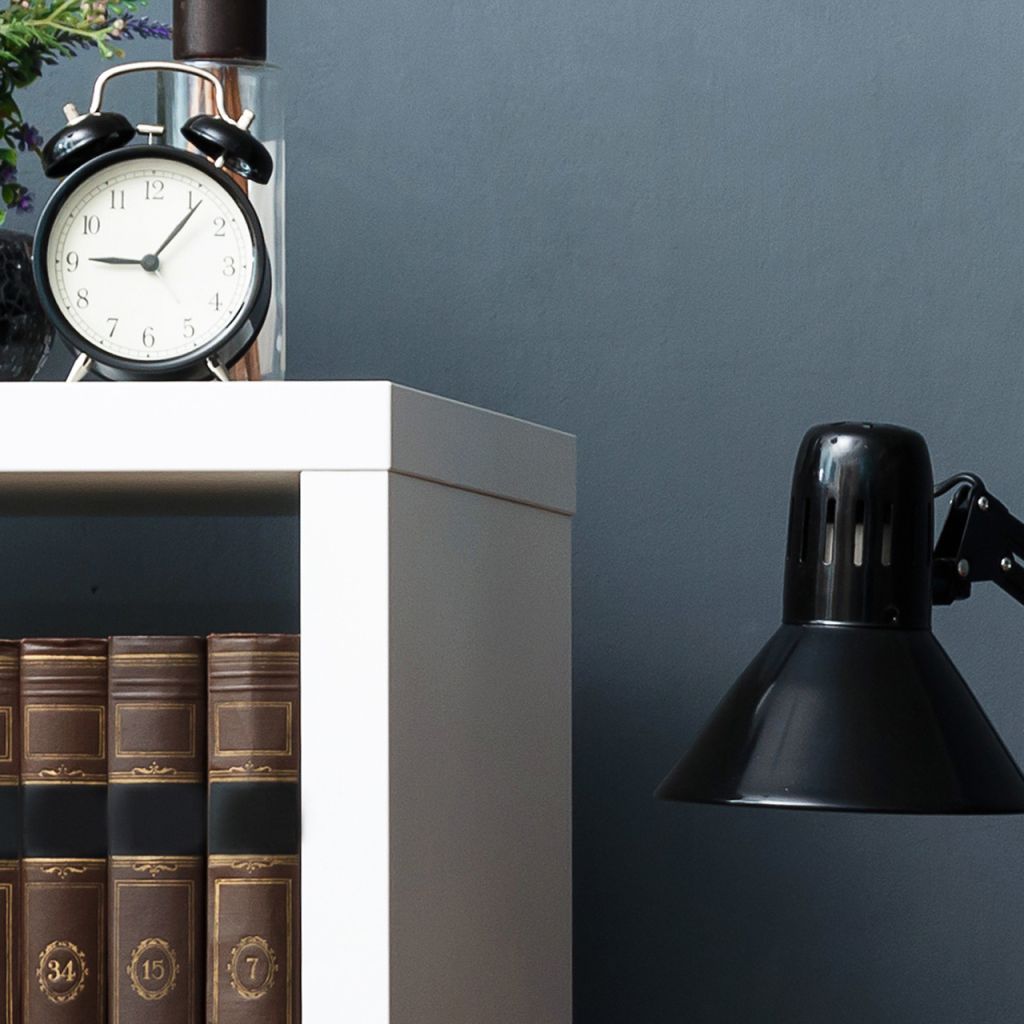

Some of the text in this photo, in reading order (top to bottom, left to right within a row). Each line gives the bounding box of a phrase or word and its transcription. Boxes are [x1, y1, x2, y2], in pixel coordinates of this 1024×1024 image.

[110, 190, 125, 209] 11
[145, 180, 164, 200] 12
[188, 190, 194, 210] 1
[83, 215, 100, 235] 10
[213, 217, 226, 237] 2
[66, 251, 79, 272] 9
[222, 256, 235, 276] 3
[76, 288, 89, 309] 8
[208, 292, 223, 311] 4
[106, 318, 119, 338] 7
[142, 327, 155, 348] 6
[183, 318, 195, 338] 5
[47, 959, 77, 982] 34
[142, 959, 166, 981] 15
[246, 957, 260, 980] 7
